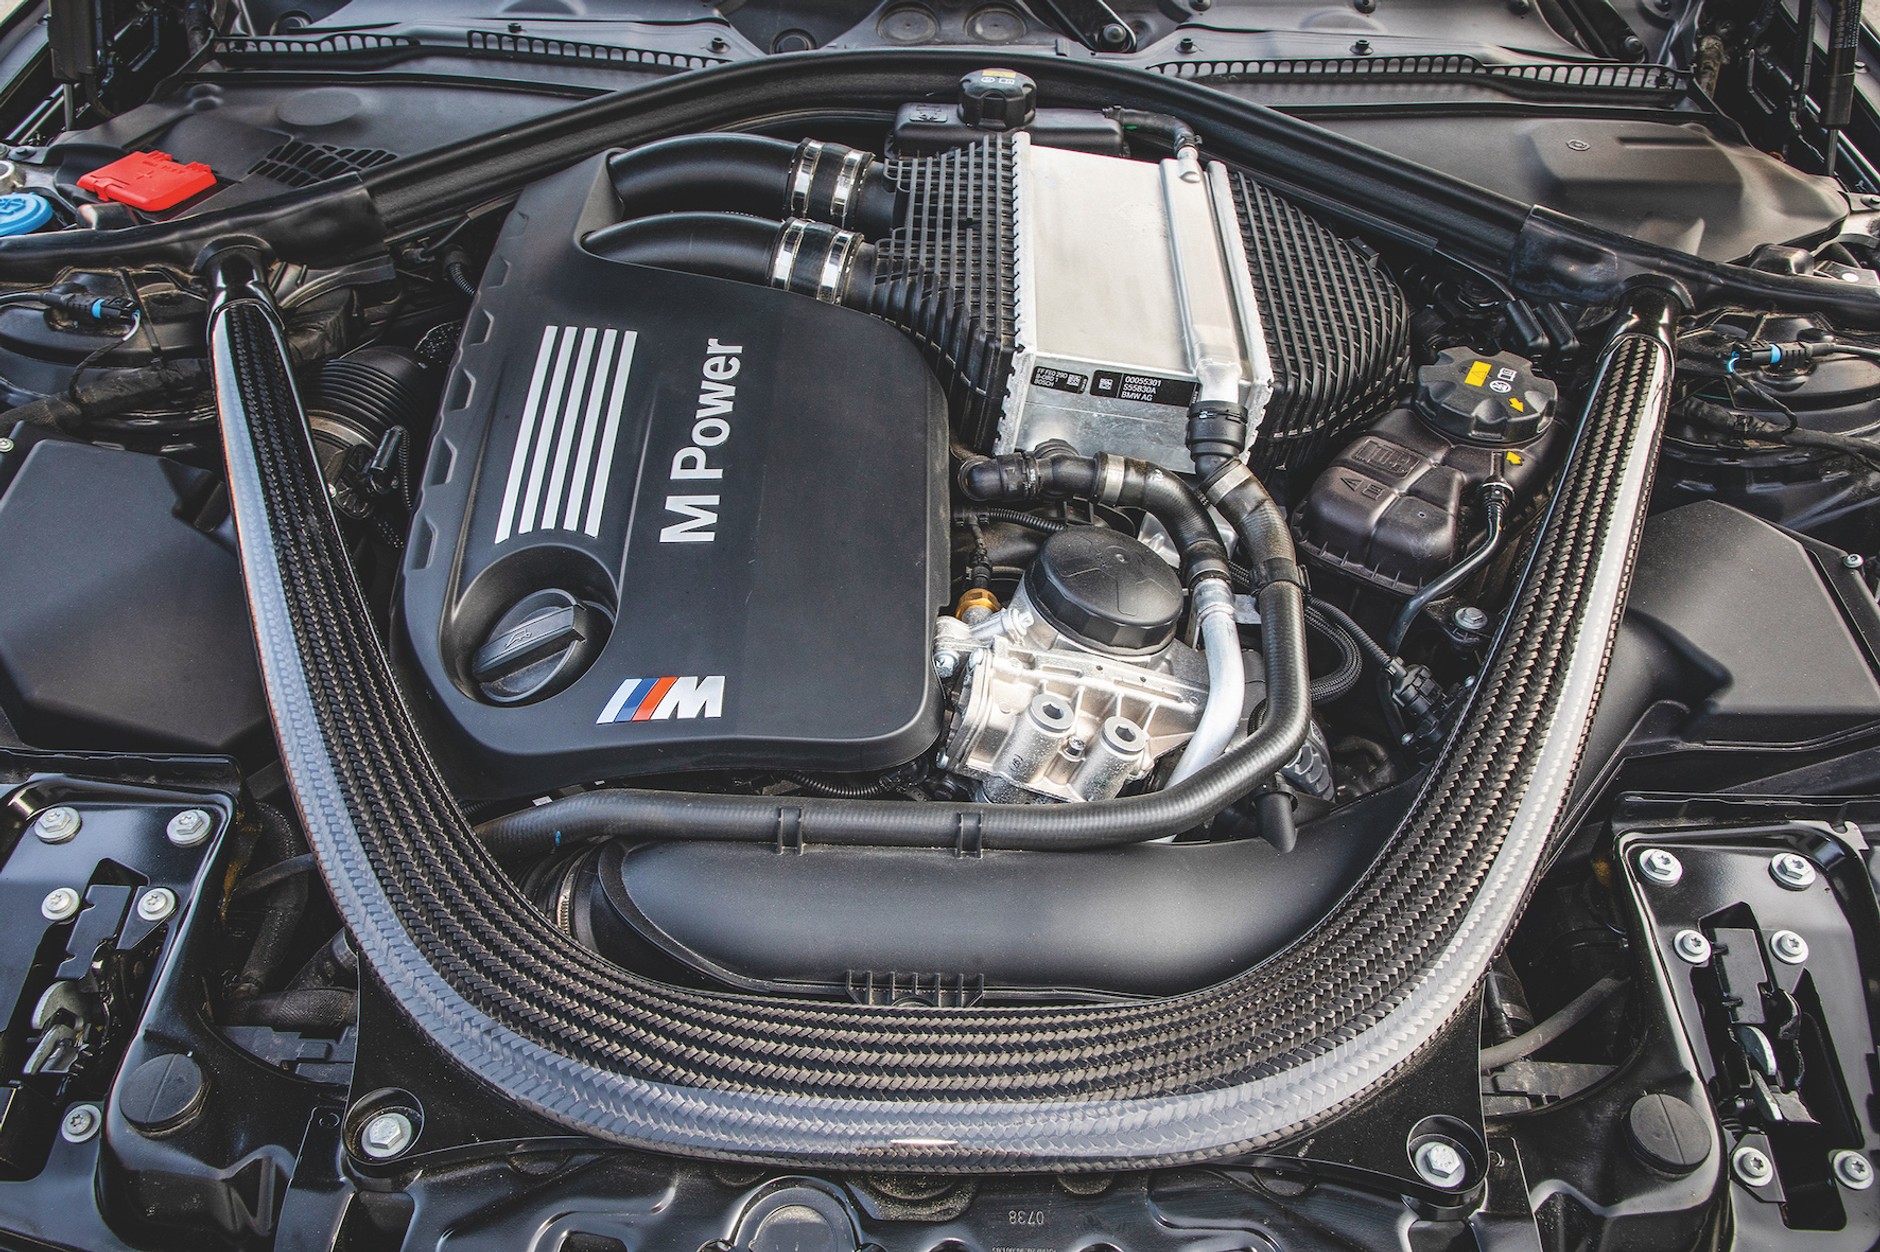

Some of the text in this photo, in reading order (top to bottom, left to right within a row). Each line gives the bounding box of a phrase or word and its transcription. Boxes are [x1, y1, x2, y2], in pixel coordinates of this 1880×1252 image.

[1125, 376, 1162, 387] 00055301
[1123, 383, 1157, 394] S55B30A
[1121, 391, 1153, 402] BMW AG
[659, 338, 744, 543] M Power
[1008, 1210, 1045, 1226] 0738
